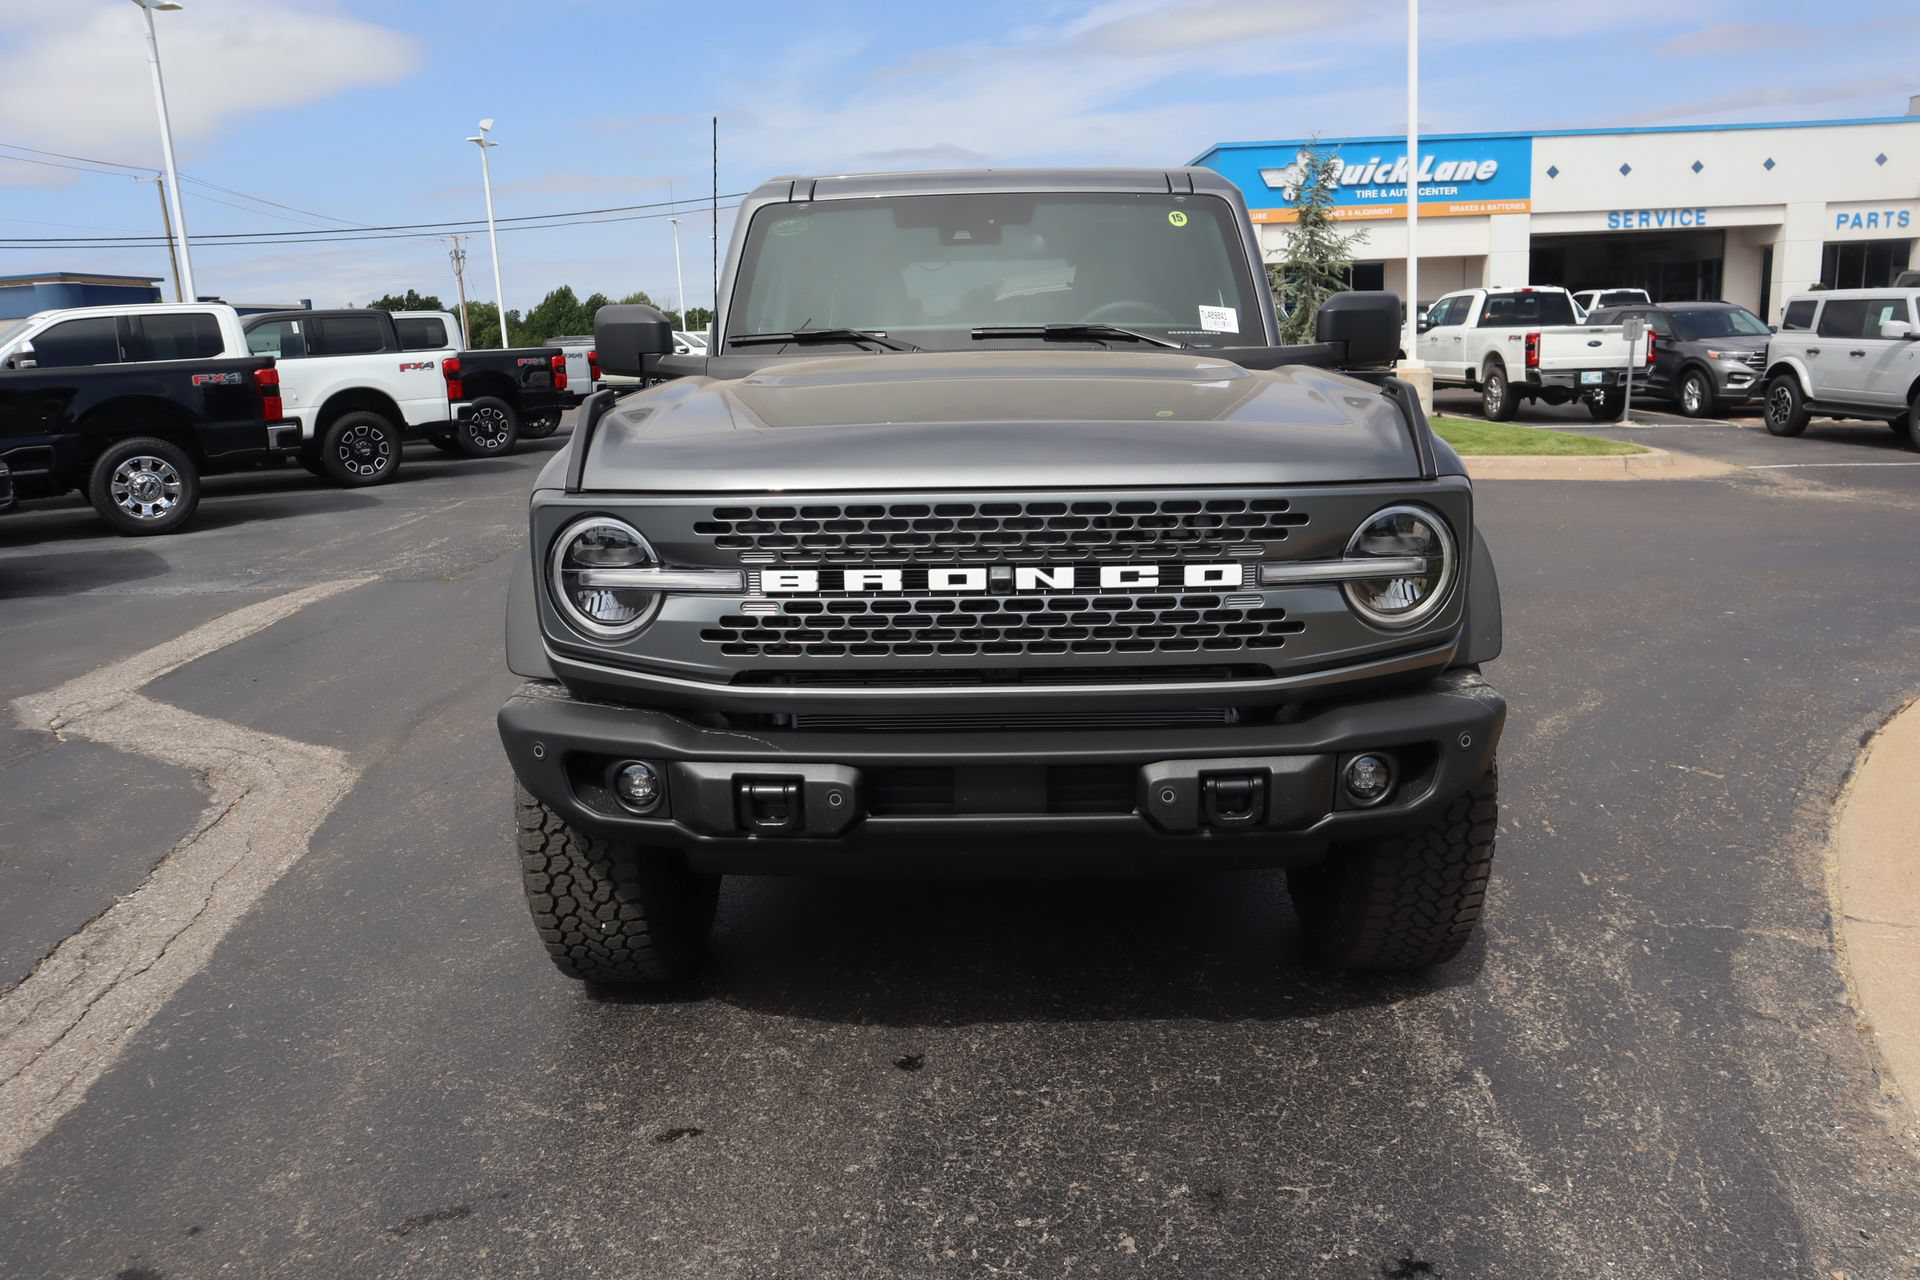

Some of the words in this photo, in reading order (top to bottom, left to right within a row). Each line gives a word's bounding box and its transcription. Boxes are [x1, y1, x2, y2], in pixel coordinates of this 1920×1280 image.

[1417, 155, 1498, 182] Lane
[1356, 189, 1379, 198] TIRE
[1380, 189, 1388, 198] &
[1389, 188, 1408, 197] AUT
[1418, 187, 1458, 196] CENTER
[1354, 207, 1394, 216] ALIGNMENT
[1487, 203, 1526, 211] BATTERIES
[1171, 213, 1184, 222] 15
[1608, 208, 1707, 229] SERVICE
[1836, 210, 1911, 230] PARTS
[399, 361, 434, 372] FX4
[517, 357, 546, 367] FX4
[192, 372, 242, 385] FX4
[761, 564, 1243, 592] BRONCO
